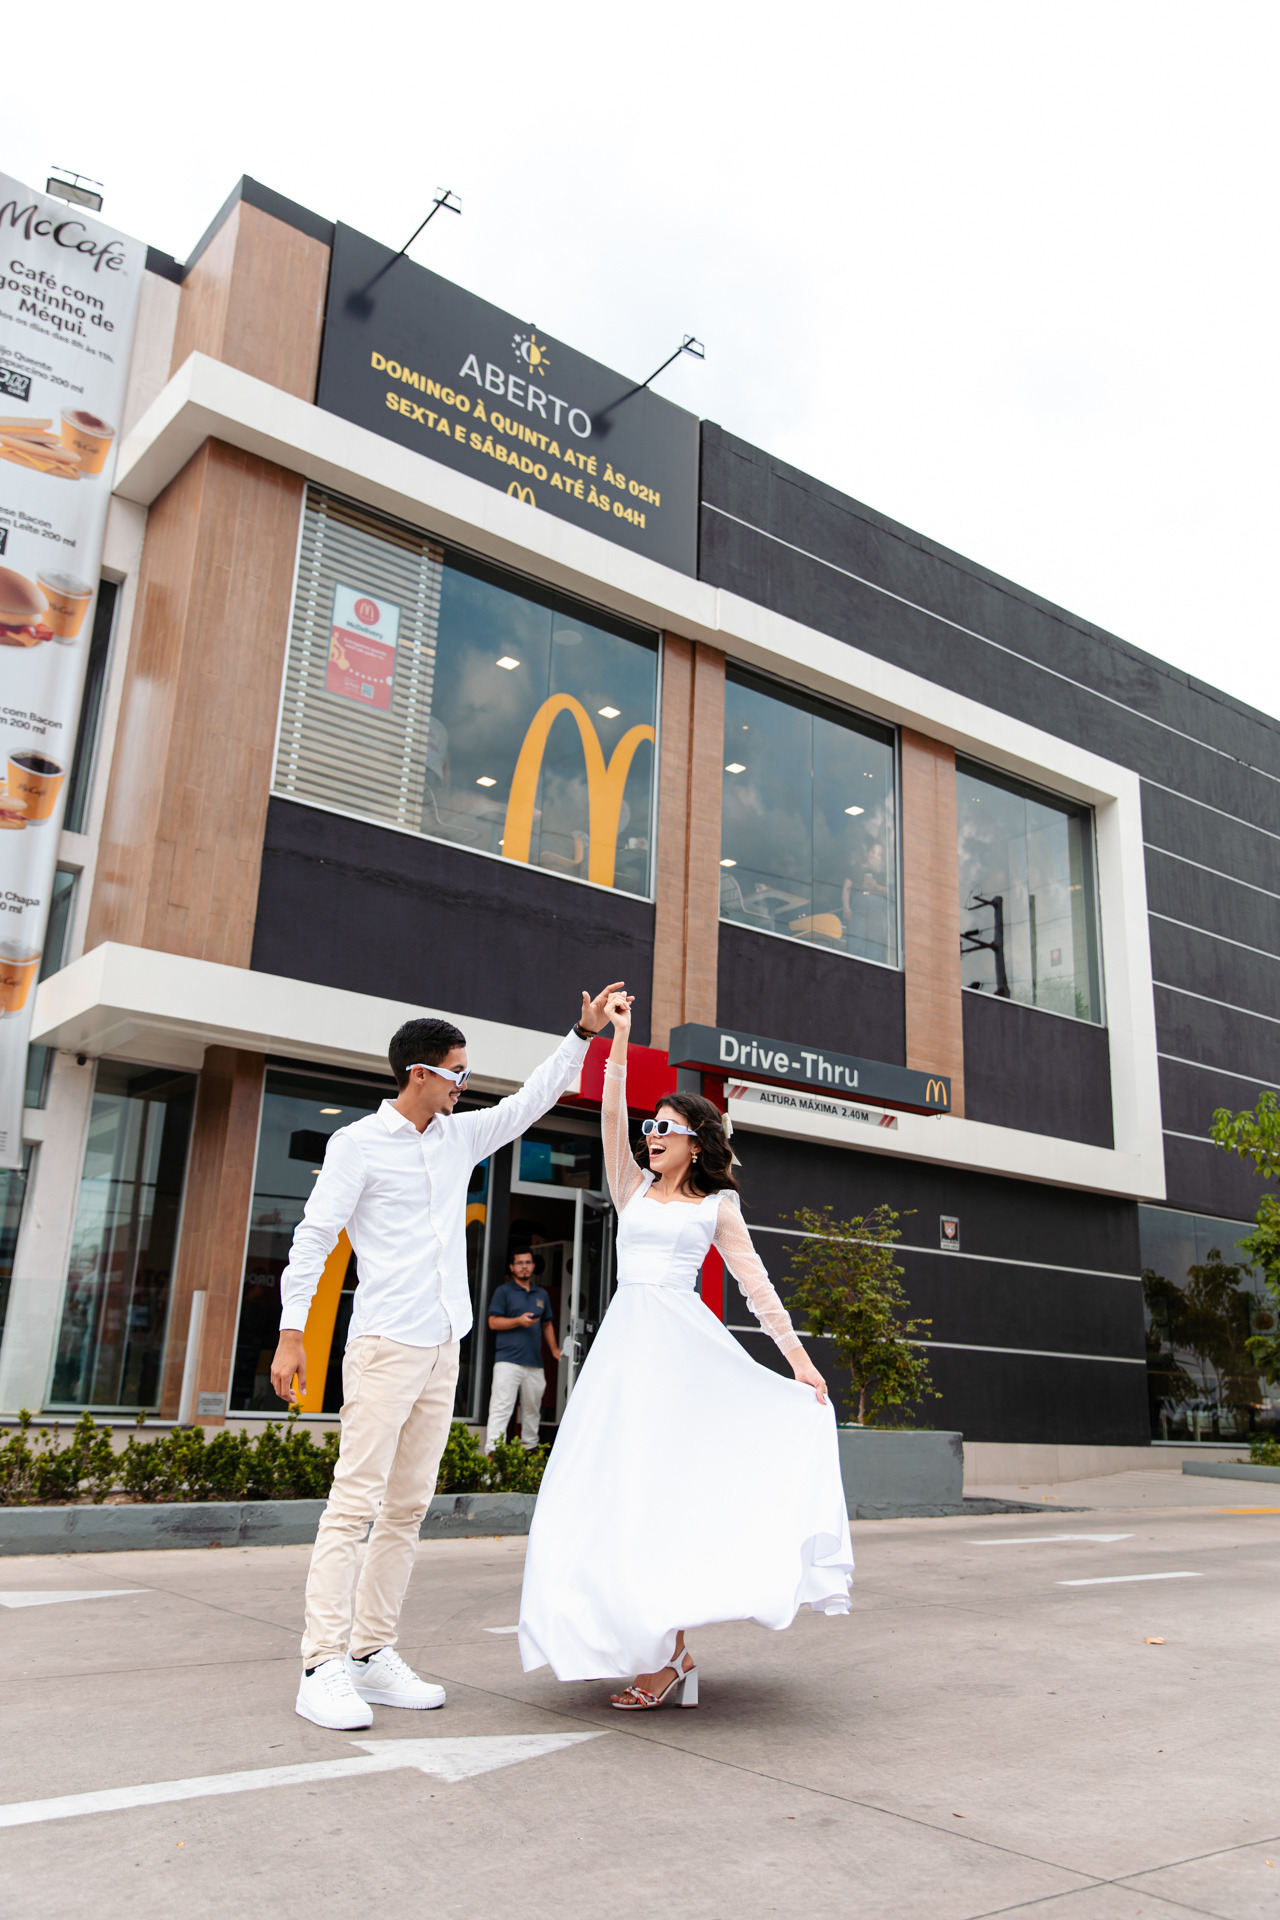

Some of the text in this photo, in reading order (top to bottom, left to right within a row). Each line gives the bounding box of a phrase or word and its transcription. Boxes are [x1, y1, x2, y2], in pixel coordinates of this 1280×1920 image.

[0, 200, 125, 272] McCafé
[10, 260, 104, 311] Café com
[19, 297, 87, 338] Méqui.
[90, 314, 115, 333] de
[29, 322, 50, 336] dias
[52, 332, 69, 344] das
[14, 351, 52, 372] Quente
[50, 374, 70, 388] 200
[71, 382, 84, 394] ml
[459, 353, 592, 437] ABERTO
[371, 351, 661, 507] DOMINGO À QUINTA ATÉ ÀS 02H
[385, 391, 646, 529] SEXTA E SÁBADO ATÉ ÀS 04H
[18, 511, 52, 529] Bacon
[13, 520, 39, 535] Leite
[41, 529, 62, 542] 200
[62, 538, 77, 549] ml
[2, 707, 63, 729] com Bacon
[9, 718, 31, 730] 200
[32, 726, 46, 735] ml
[5, 890, 40, 907] Chapa
[8, 905, 23, 914] ml
[719, 1034, 859, 1088] Drive-Thru
[760, 1092, 869, 1122] ALTURA MÁXIMA 2.40M
